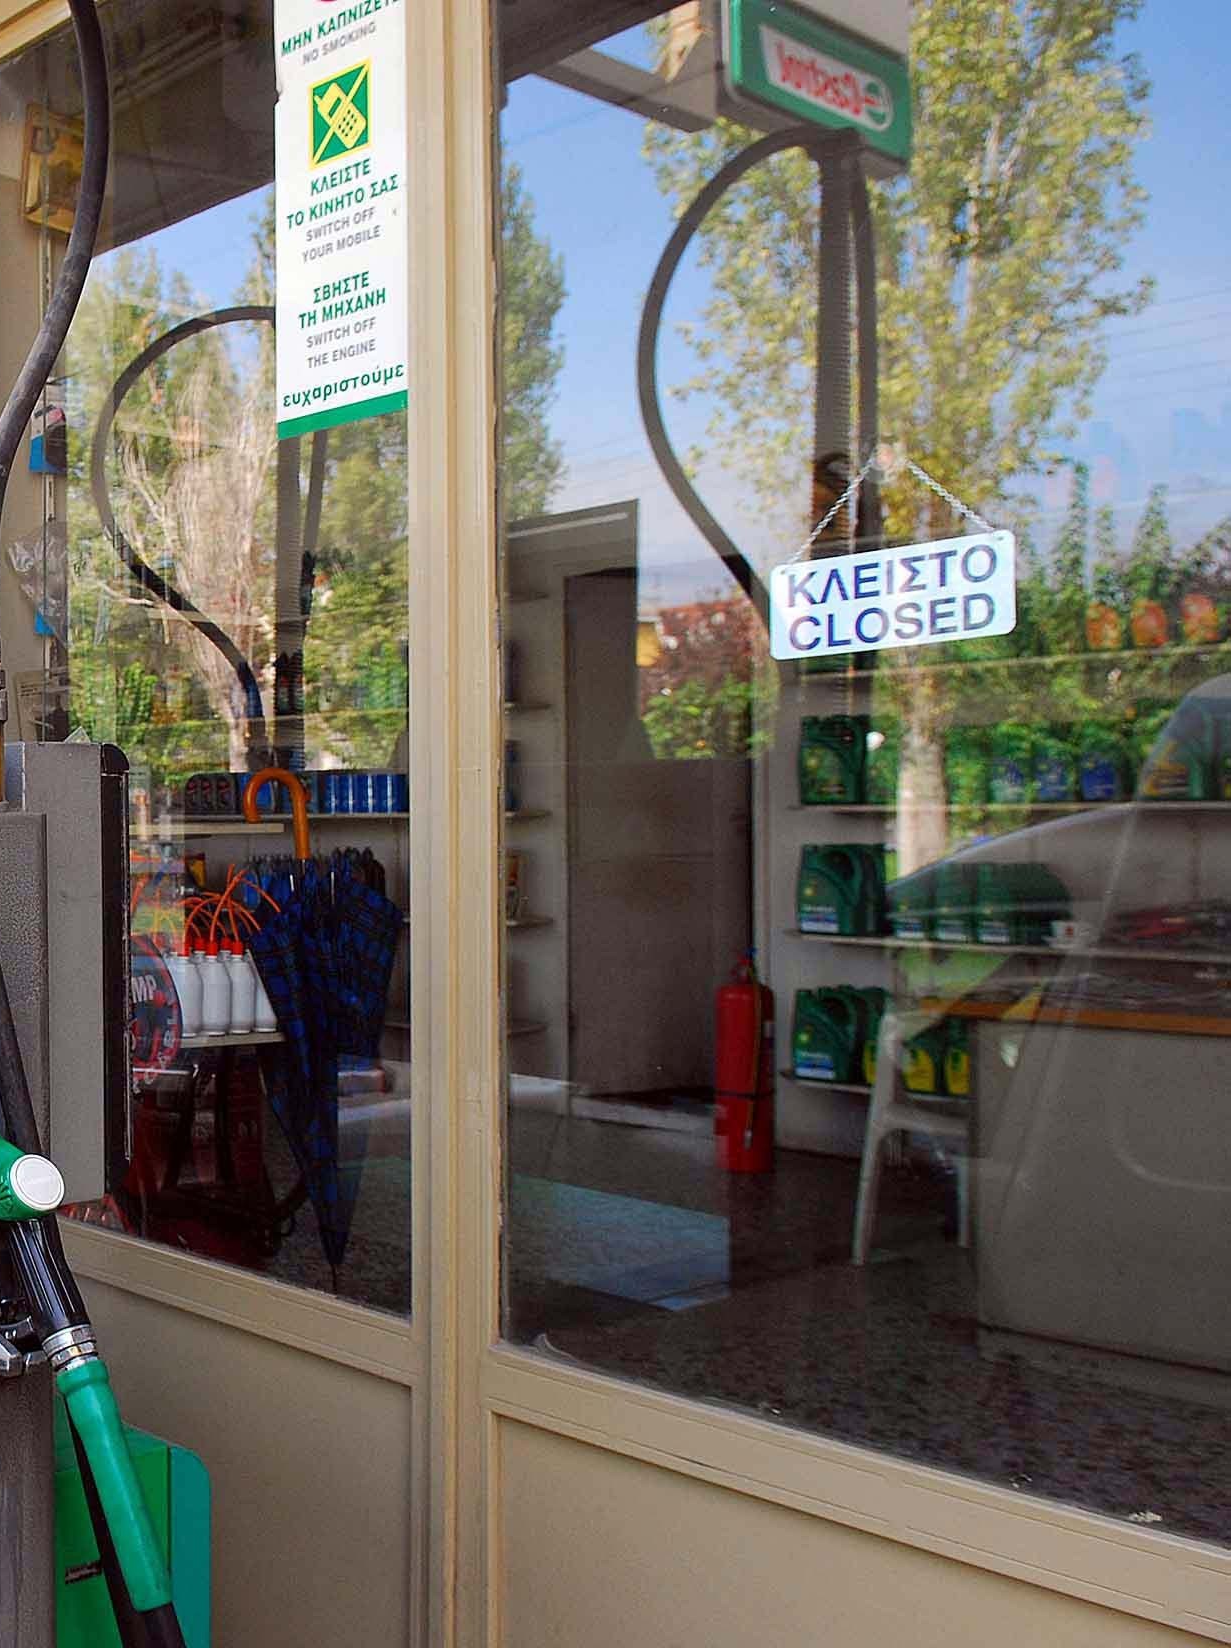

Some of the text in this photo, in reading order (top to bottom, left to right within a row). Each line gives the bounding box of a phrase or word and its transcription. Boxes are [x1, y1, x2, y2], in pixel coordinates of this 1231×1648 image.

[281, 0, 399, 56] ΜΗΝ ΚΑΠΝΙΖΕ
[302, 22, 376, 65] NO SMOKING
[310, 158, 371, 196] ΚΛΕΙΣΤΕ
[287, 174, 399, 229] ΤΟ ΚΙΝΗΤΟ ΣΑΣ
[302, 224, 381, 264] YOUR MOBILE
[306, 206, 375, 242] SWITCH OFF
[298, 287, 386, 329] ΤΗ ΜΗΧΑΝΗ
[313, 270, 369, 304] ΣΒΗΣΤΕ
[306, 317, 376, 348] SWITCH OFF
[307, 339, 376, 368] THE ENGINE
[283, 364, 405, 407] ευχαριστούμε
[788, 544, 997, 608] ΚΛΕΙΣΤΟ
[789, 592, 996, 650] CLOSED
